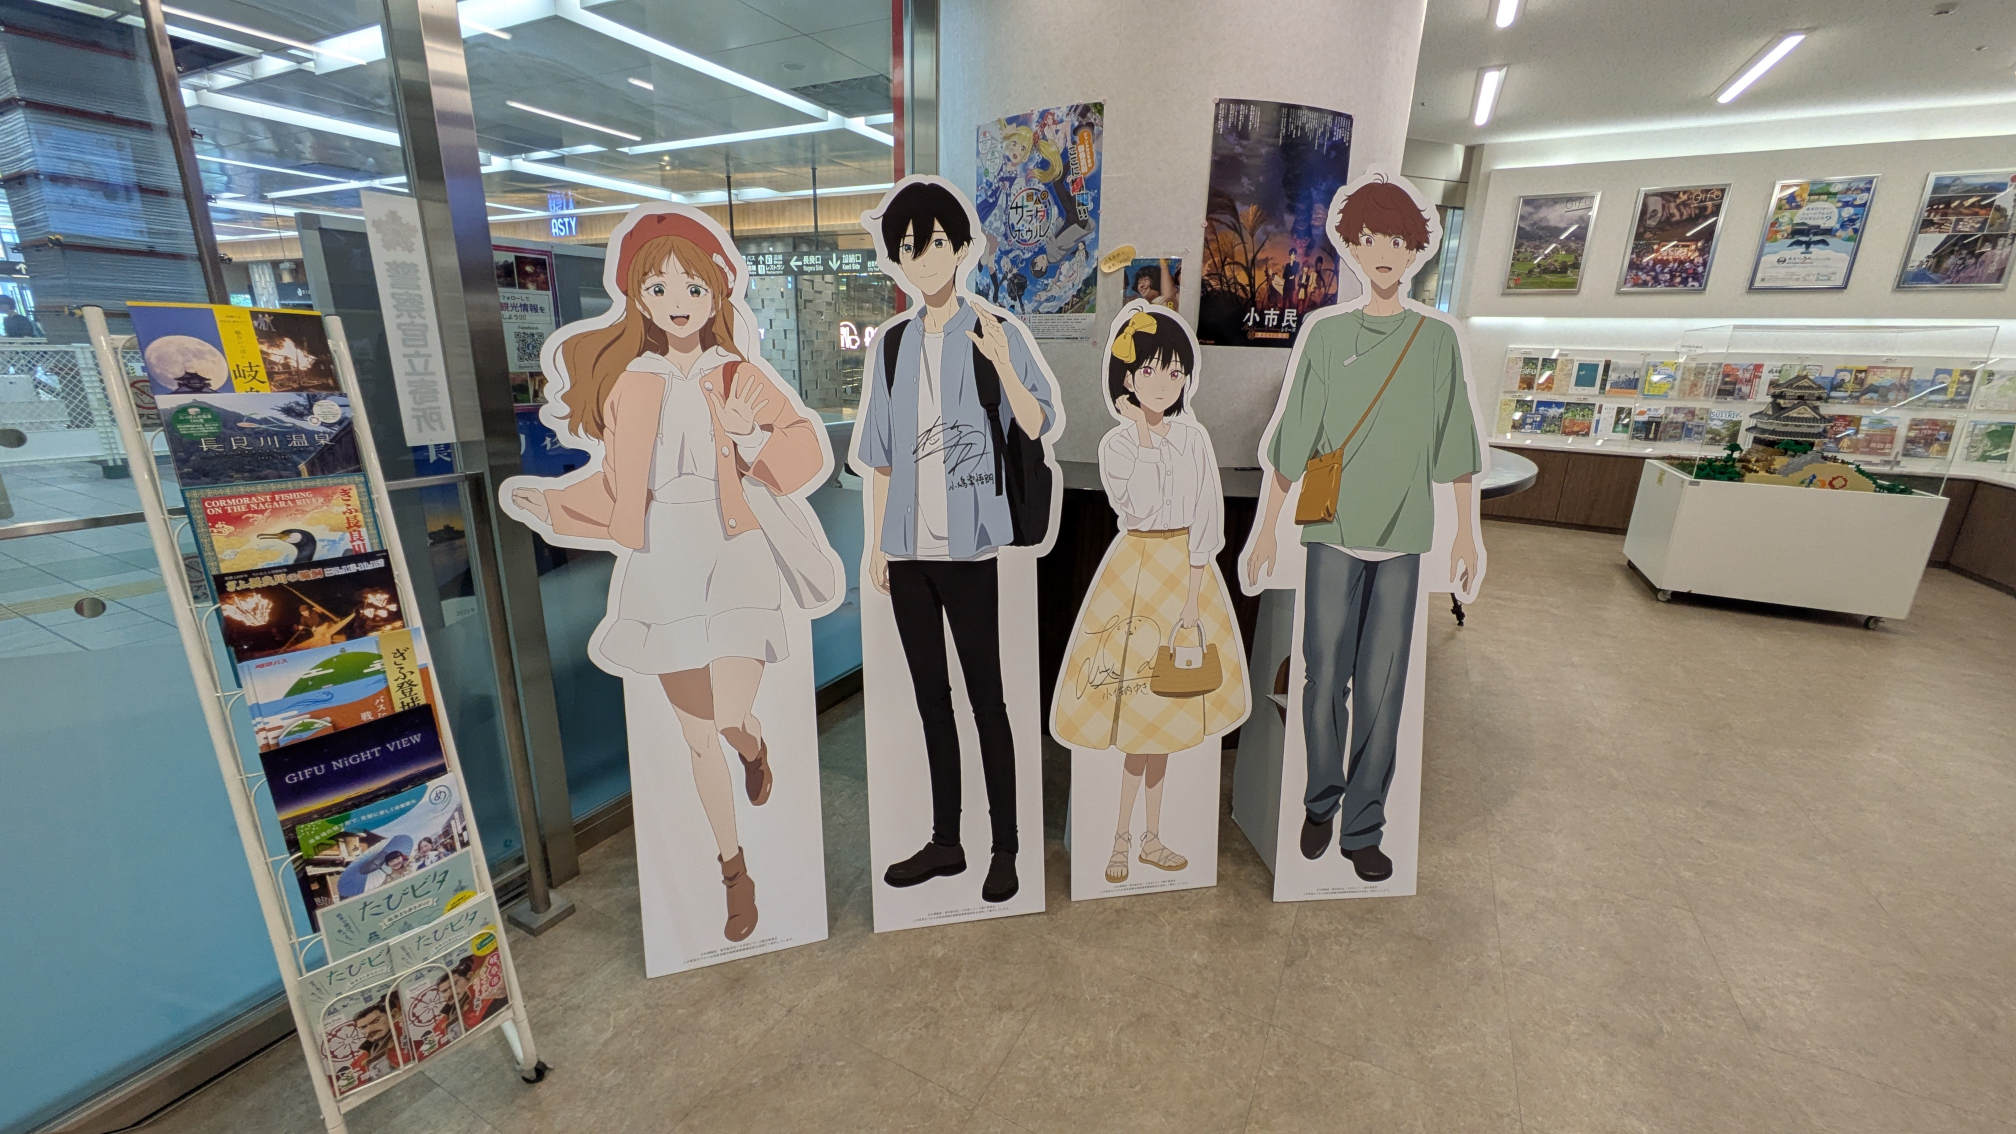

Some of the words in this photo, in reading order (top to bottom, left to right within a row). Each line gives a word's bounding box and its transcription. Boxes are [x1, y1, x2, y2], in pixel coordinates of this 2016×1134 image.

[1010, 196, 1046, 225] サラダ
[551, 217, 576, 236] ASTY
[1013, 223, 1050, 241] ボウル
[803, 255, 821, 264] 長良口
[1242, 306, 1298, 328] 小市民
[200, 433, 340, 452] 長良川温泉
[204, 495, 273, 509] CORMORANT
[274, 491, 313, 502] FISHING
[207, 507, 222, 515] ON
[225, 504, 249, 513] THE
[250, 500, 294, 511] NAGARA
[295, 497, 326, 506] RIVER
[284, 764, 326, 784] GIFU
[386, 733, 423, 752] VIEW
[433, 789, 447, 802] め
